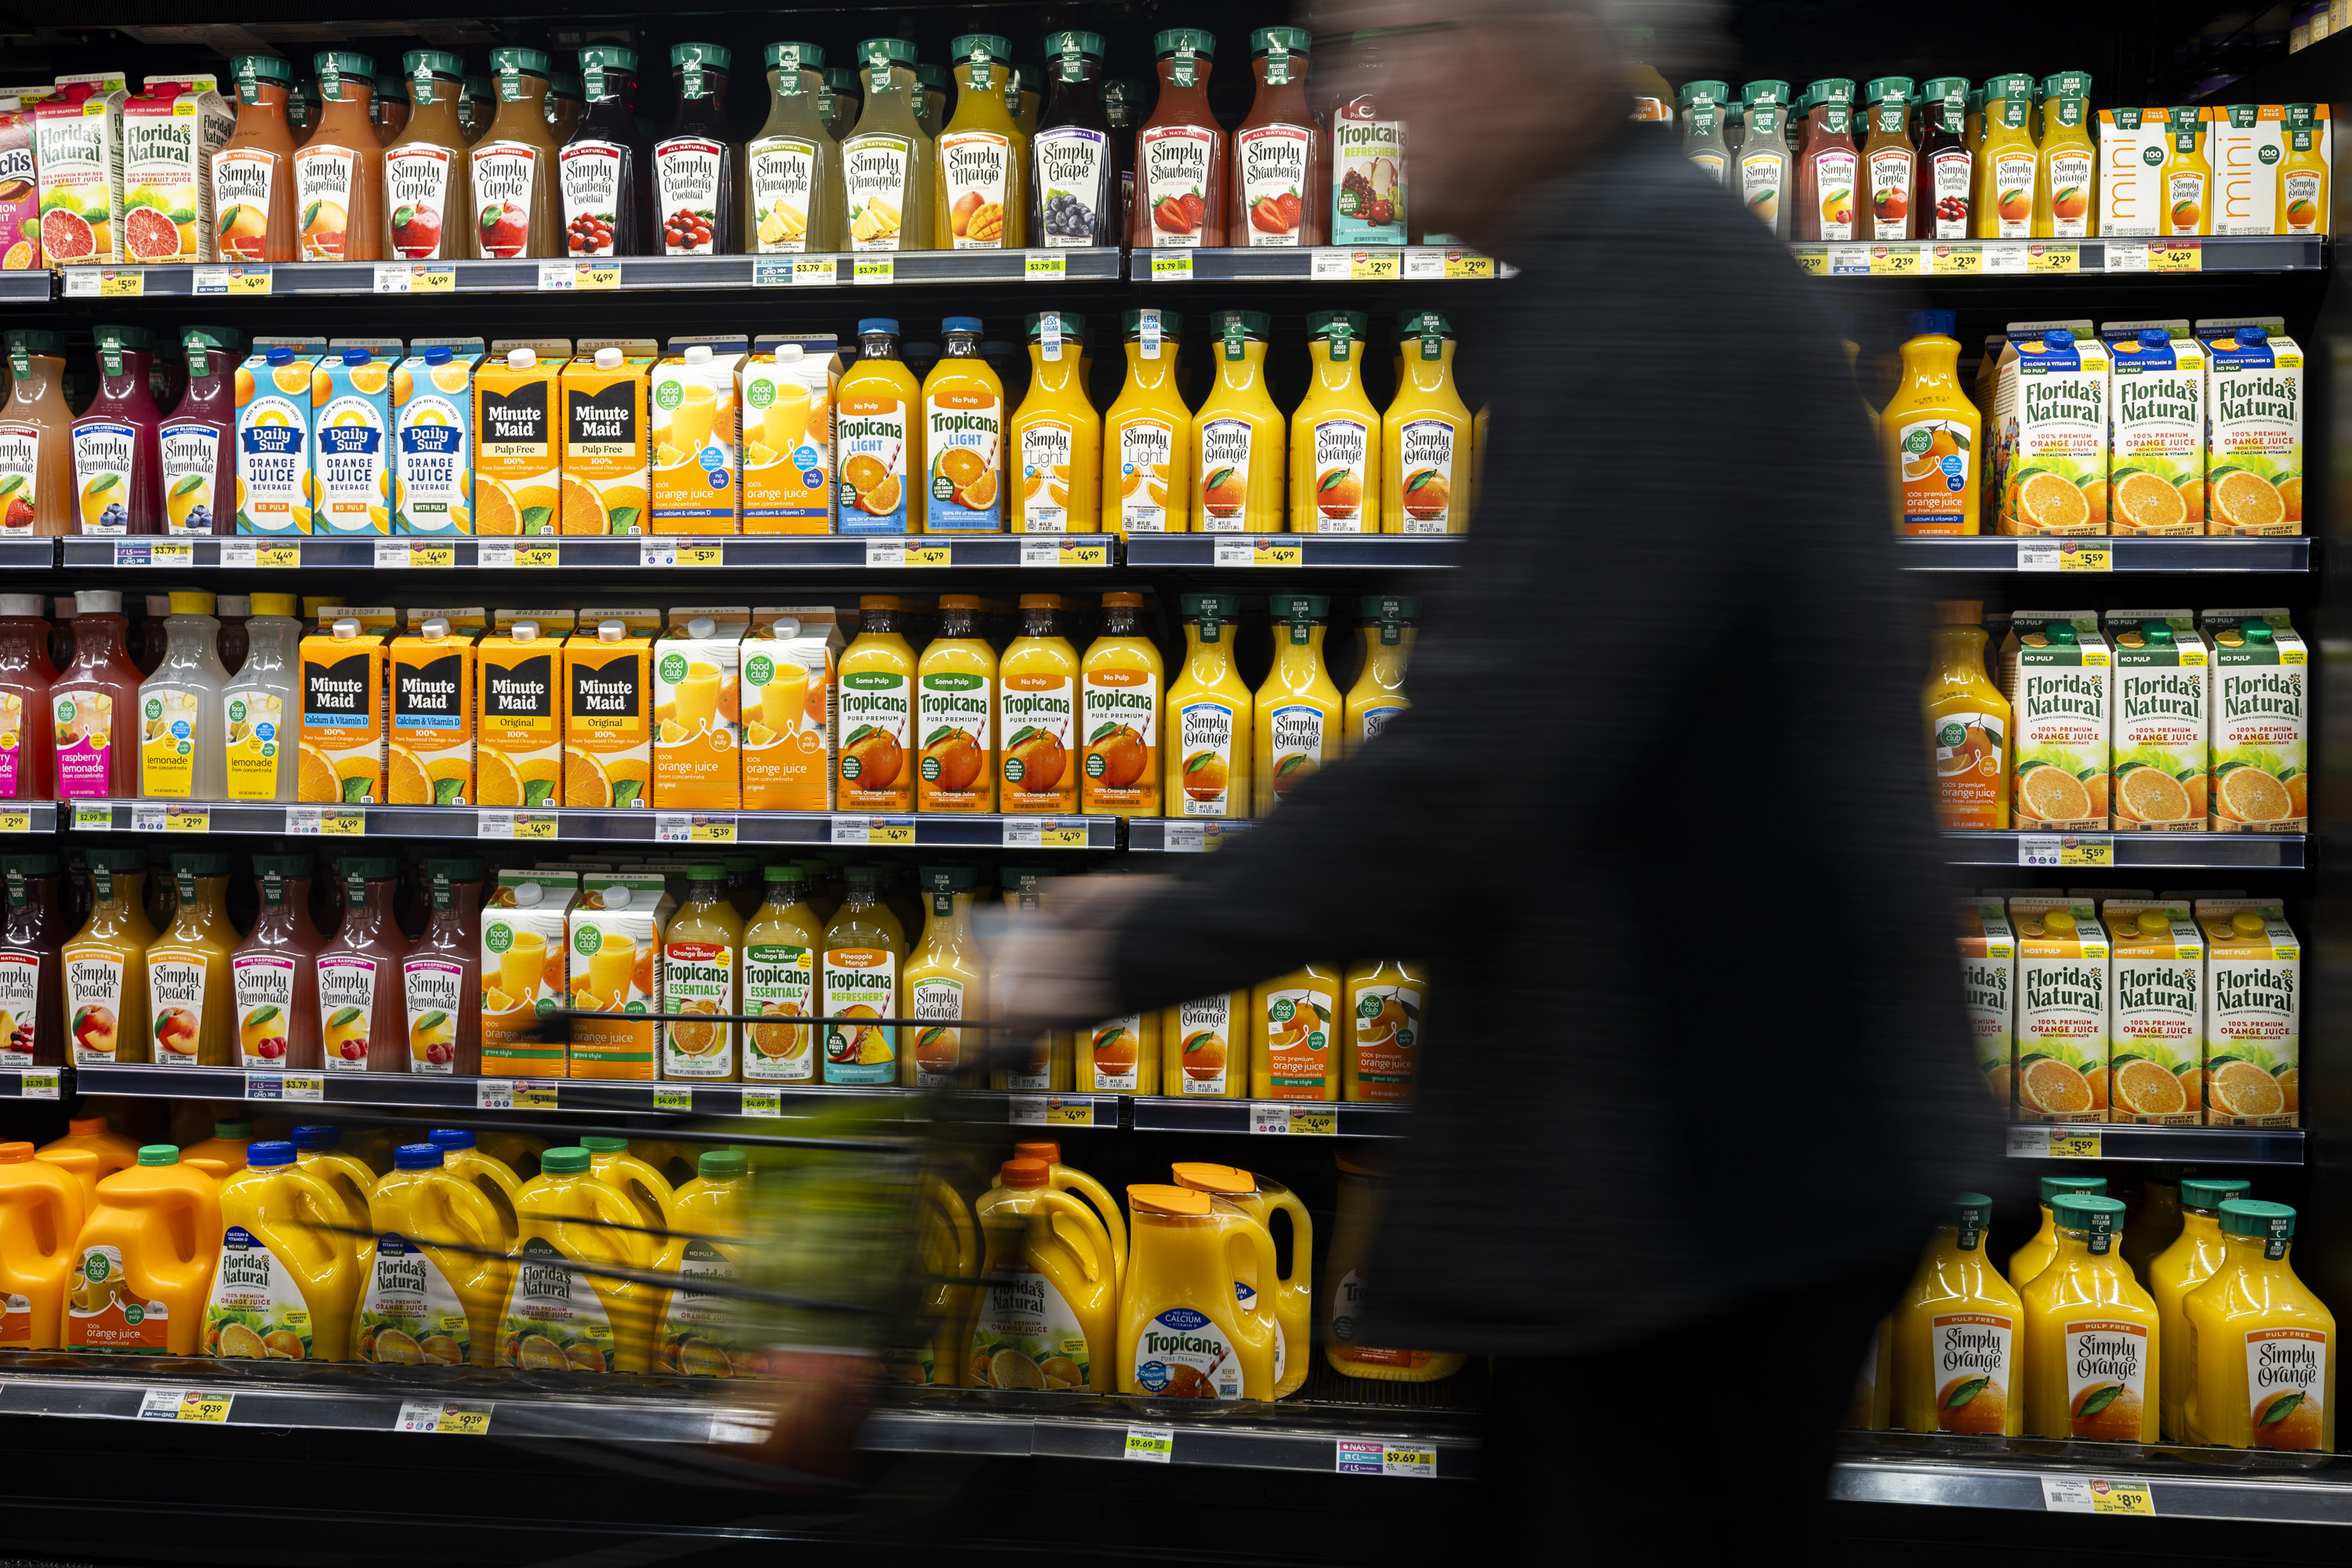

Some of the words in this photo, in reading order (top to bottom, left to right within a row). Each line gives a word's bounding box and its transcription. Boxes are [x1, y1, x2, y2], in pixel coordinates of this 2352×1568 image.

[1338, 122, 1407, 147] Tropicana
[129, 143, 189, 164] Natural
[949, 147, 1001, 171] Simply
[1043, 142, 1095, 167] Simply
[1345, 147, 1399, 157] REFRESHERS
[218, 160, 267, 186] Simply
[392, 159, 441, 183] Simply
[663, 156, 712, 180] Simply
[953, 165, 999, 185] Mango
[1049, 160, 1090, 182] Grape
[2054, 160, 2088, 175] Simply
[664, 176, 713, 194] Cranberry
[2054, 171, 2088, 186] Orange
[2103, 138, 2136, 218] mini
[672, 189, 703, 201] Cocktail
[488, 407, 540, 421] Minute
[2027, 401, 2099, 424] Natural
[495, 422, 532, 437] Maid
[931, 412, 998, 434] Tropicana
[253, 429, 291, 442] Daily
[949, 434, 982, 445] LIGHT
[1123, 428, 1168, 450] Simply
[78, 437, 128, 461] Simply
[259, 440, 284, 451] Sun
[495, 446, 515, 455] Pulp
[78, 456, 129, 476] Lemonade
[249, 459, 295, 468] ORANGE
[1129, 448, 1163, 467] Light
[249, 469, 294, 481] JUICE
[655, 489, 688, 500] orange
[690, 488, 713, 500] juice
[311, 677, 362, 693] Minute
[874, 677, 889, 685] Pulp
[317, 693, 355, 707] Maid
[841, 692, 907, 714] Tropicana
[2027, 695, 2100, 717] Natural
[362, 717, 368, 725] D
[1185, 713, 1228, 733] Simply
[1185, 731, 1229, 748] Orange
[62, 753, 101, 763] raspberry
[63, 764, 103, 772] lemonade
[659, 762, 691, 773] orange
[695, 761, 718, 773] juice
[71, 964, 118, 985] Simply
[665, 963, 728, 983] Tropicana
[73, 982, 112, 1001] Peach
[670, 984, 720, 996] ESSENTIALS
[831, 992, 884, 1002] REFRESHERS
[286, 1081, 307, 1090] $3.79
[223, 1269, 268, 1286] Natural
[1165, 1314, 1201, 1323] CALCIUM
[1145, 1332, 1221, 1356] Tropicana
[2078, 1334, 2137, 1363] Simply
[2077, 1358, 2136, 1380] Orange
[1131, 1439, 1152, 1448] $9.69
[1388, 1452, 1415, 1462] $9.69
